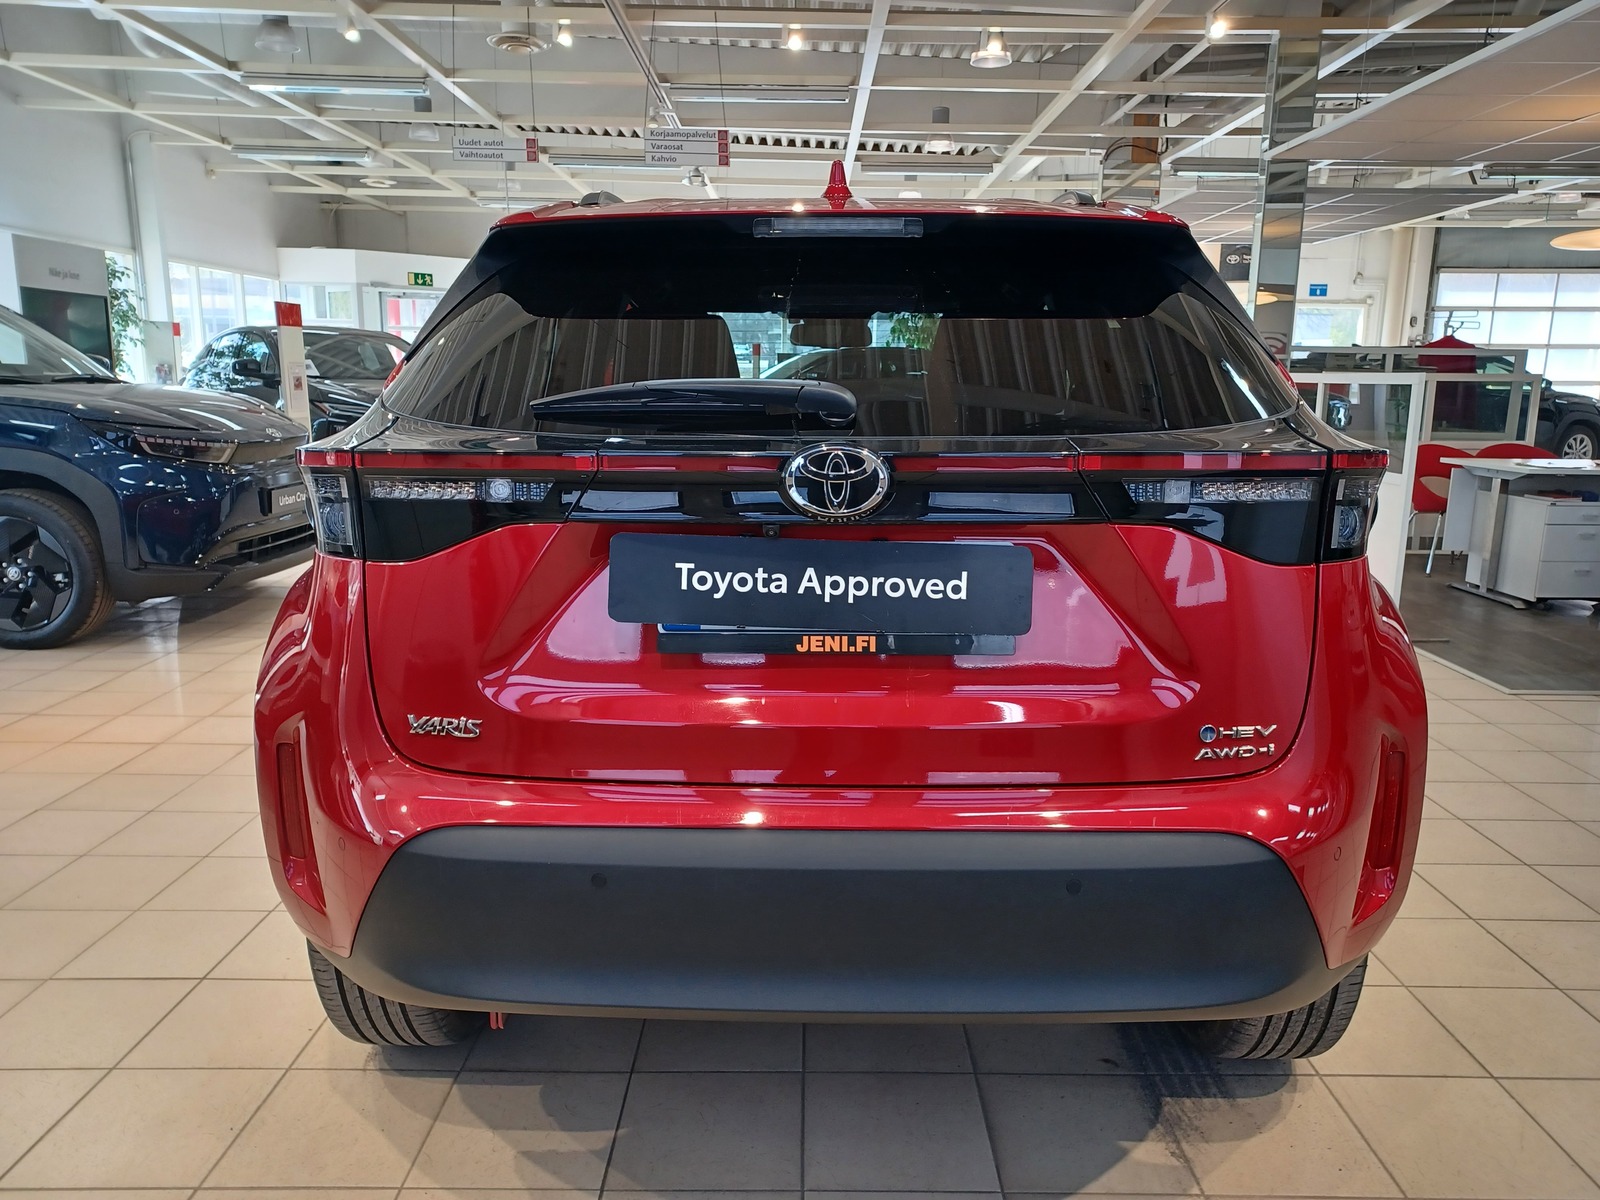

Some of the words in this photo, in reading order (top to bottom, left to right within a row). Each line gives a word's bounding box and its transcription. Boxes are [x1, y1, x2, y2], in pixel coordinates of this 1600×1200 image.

[650, 129, 717, 139] Korjaamopalvelut
[458, 138, 481, 147] Uudet
[651, 142, 683, 151] Varaosat
[459, 151, 504, 159] Vaihtoautot
[651, 155, 677, 163] Kahvio
[279, 494, 295, 506] Urban
[675, 562, 788, 599] Toyota
[797, 566, 968, 603] Approved
[796, 635, 876, 653] JENI.FI
[1218, 724, 1277, 738] HEV
